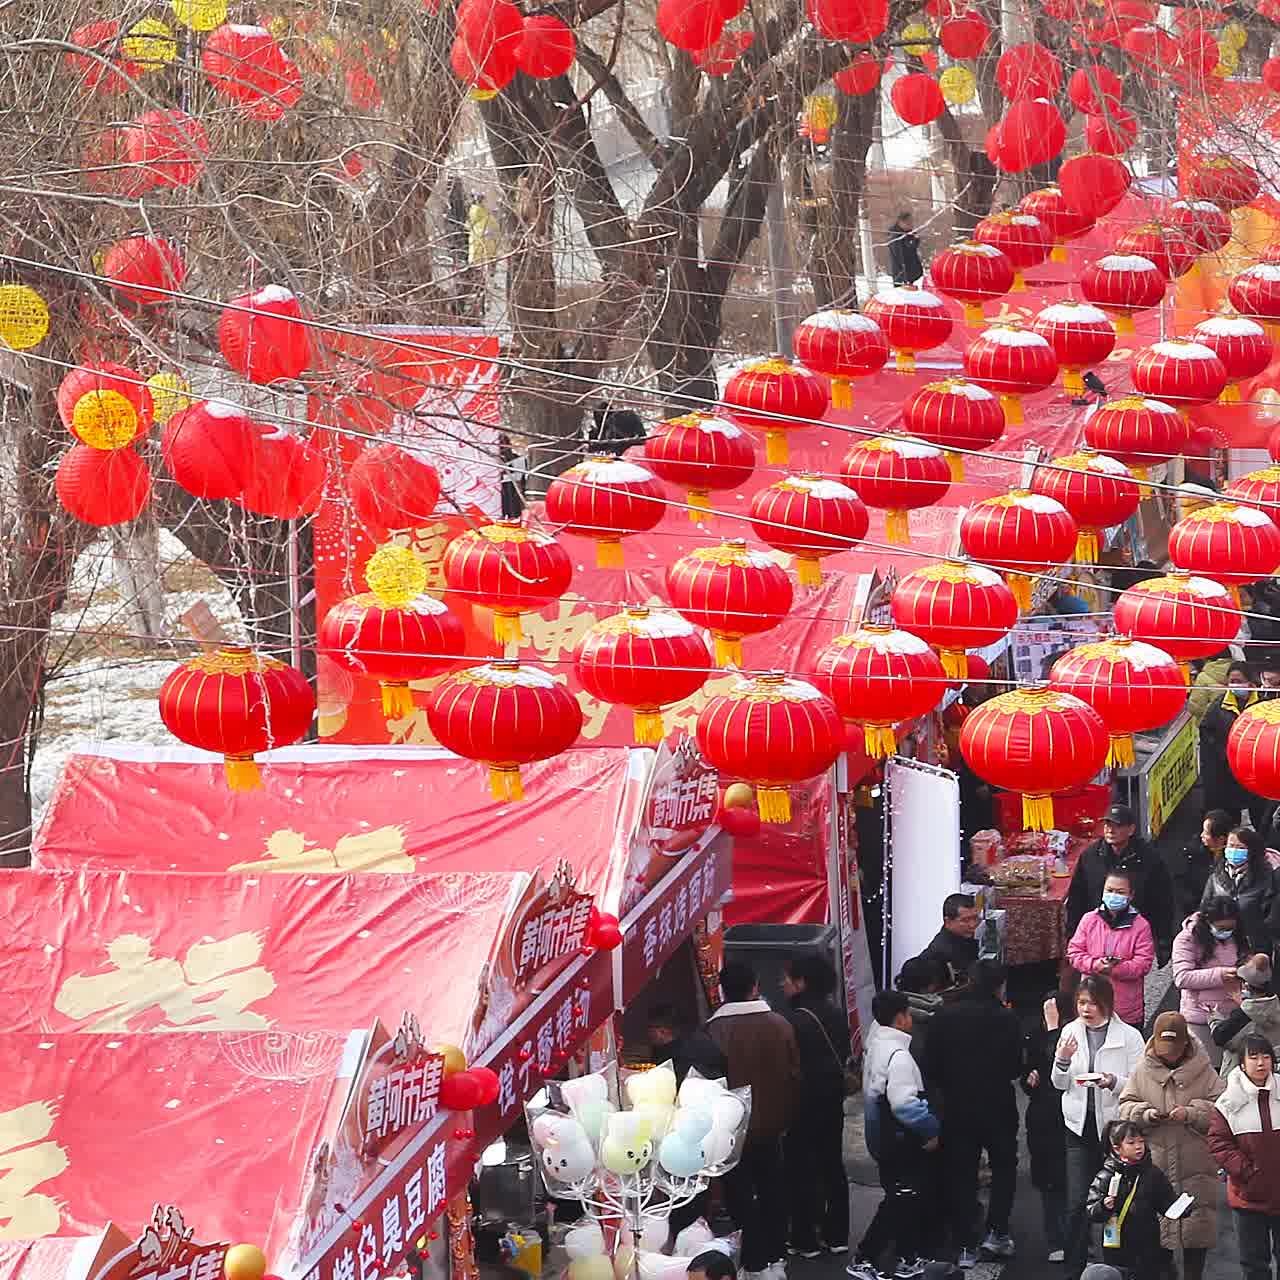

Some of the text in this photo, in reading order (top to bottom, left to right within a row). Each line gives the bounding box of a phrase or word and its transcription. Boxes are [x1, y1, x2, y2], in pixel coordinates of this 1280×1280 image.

[518, 899, 592, 977] 黄河市集
[362, 1058, 445, 1144] 黄河市集
